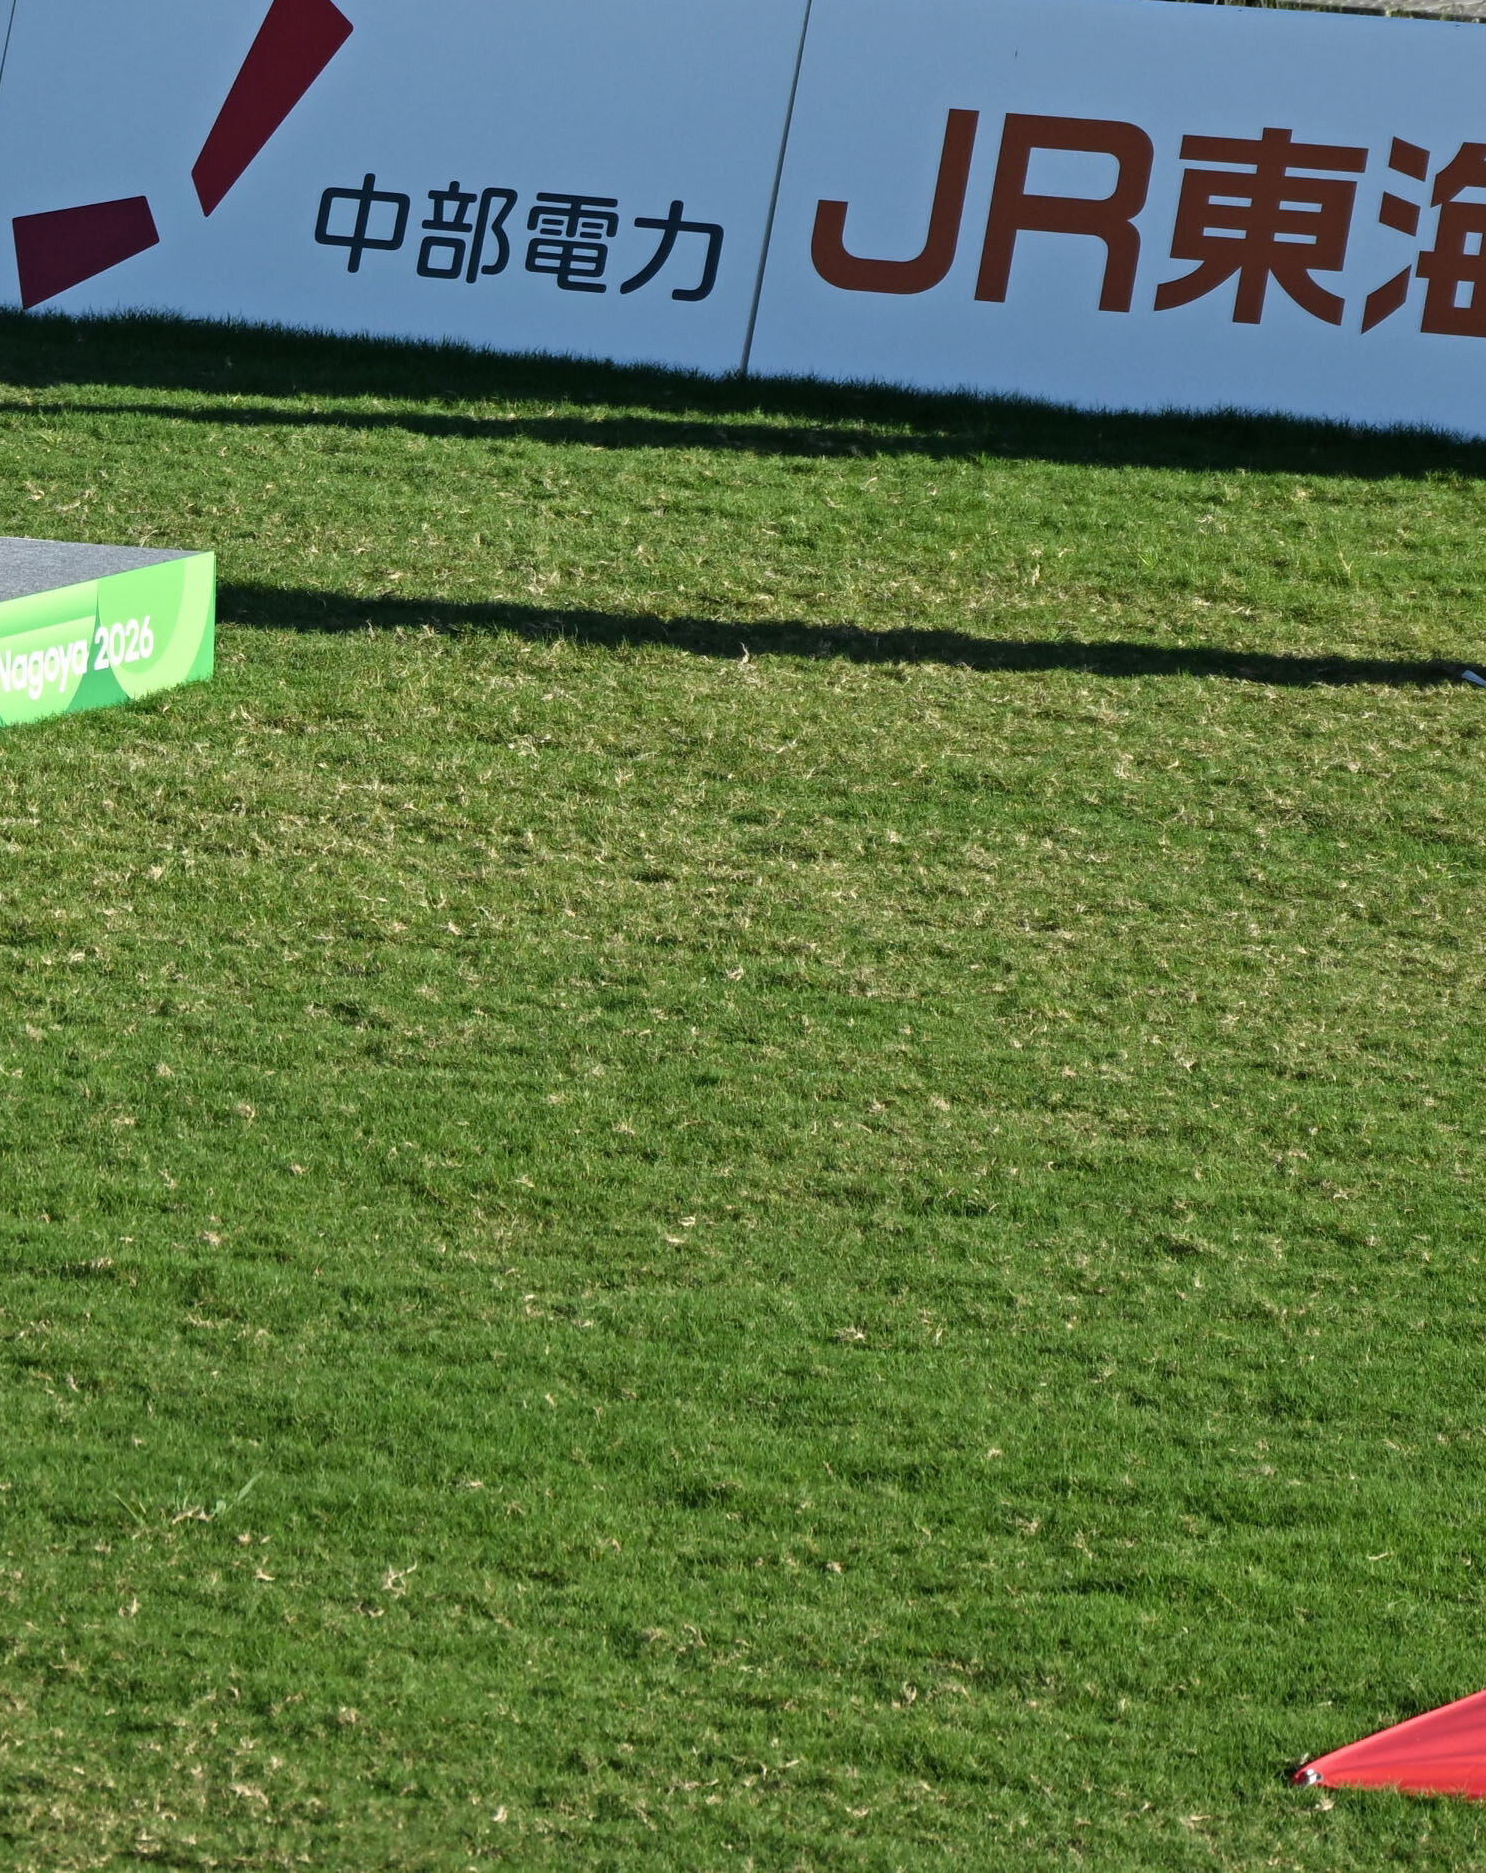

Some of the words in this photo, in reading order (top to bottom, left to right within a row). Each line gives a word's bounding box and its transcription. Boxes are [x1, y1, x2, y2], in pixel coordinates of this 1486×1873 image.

[314, 172, 725, 302] 中部電力
[94, 615, 154, 672] 2026
